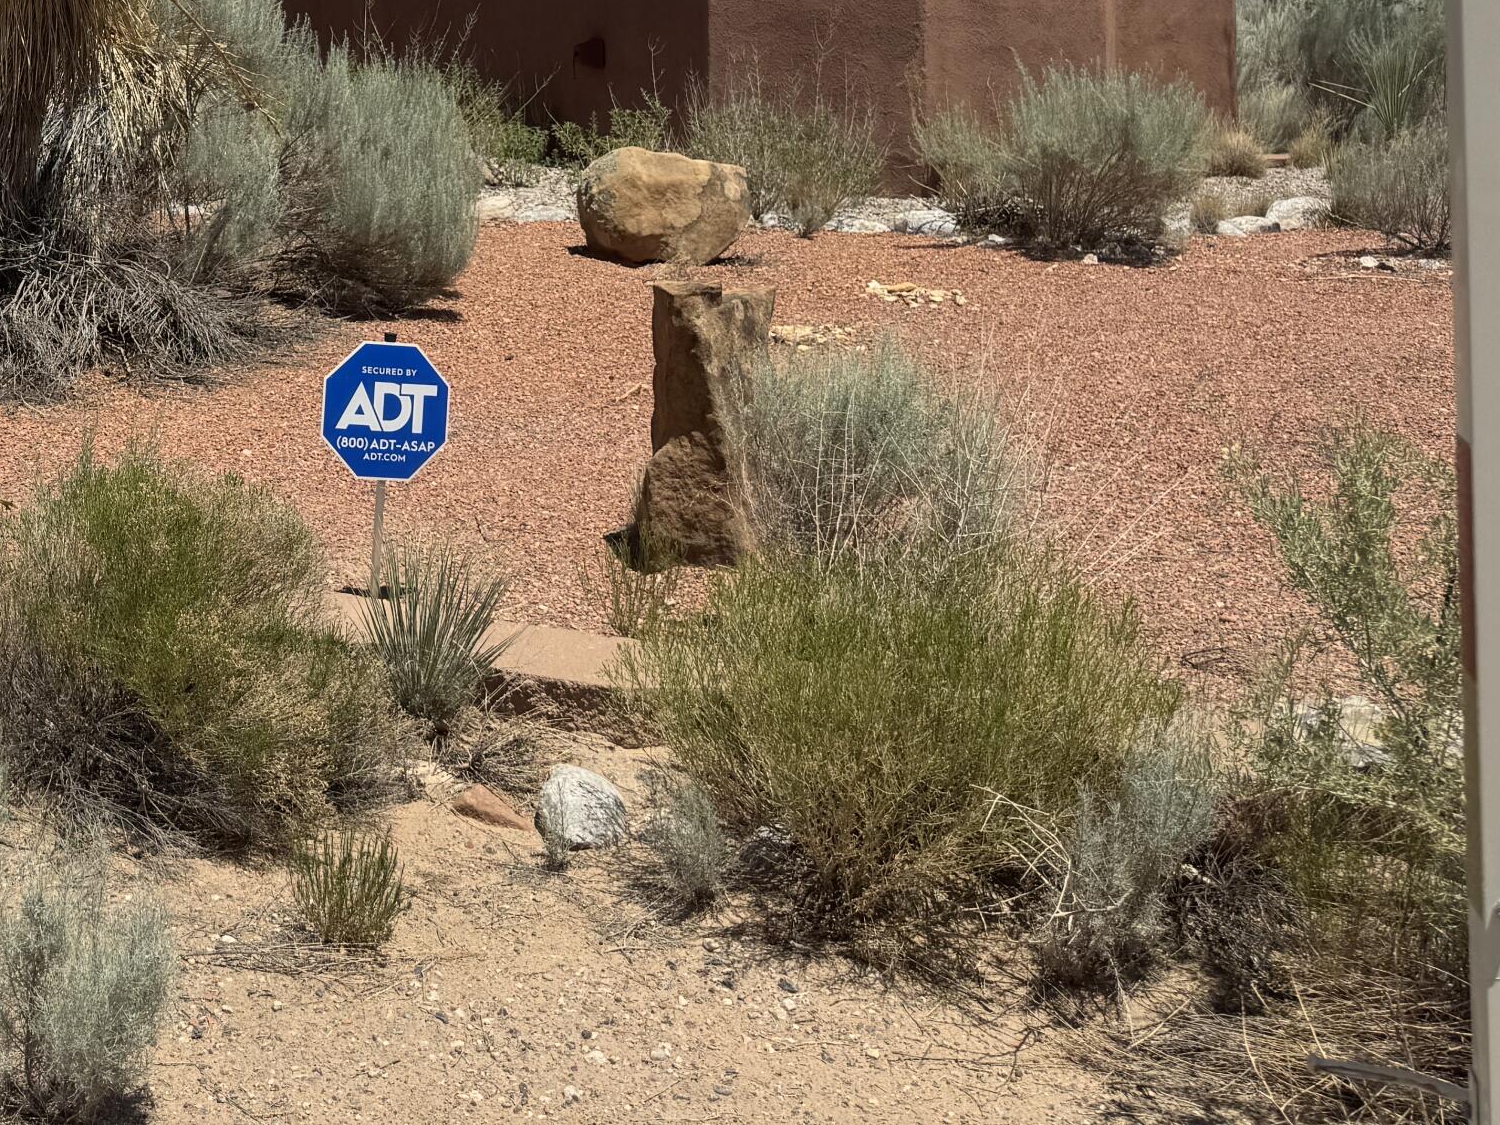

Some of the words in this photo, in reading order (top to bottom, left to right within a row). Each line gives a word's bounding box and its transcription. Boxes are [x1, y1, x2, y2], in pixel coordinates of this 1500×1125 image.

[361, 366, 403, 376] SECURED
[335, 381, 438, 434] ADT
[336, 436, 369, 451] (800)
[369, 438, 436, 452] ADT-ASAP
[363, 453, 406, 462] ADT.COM
